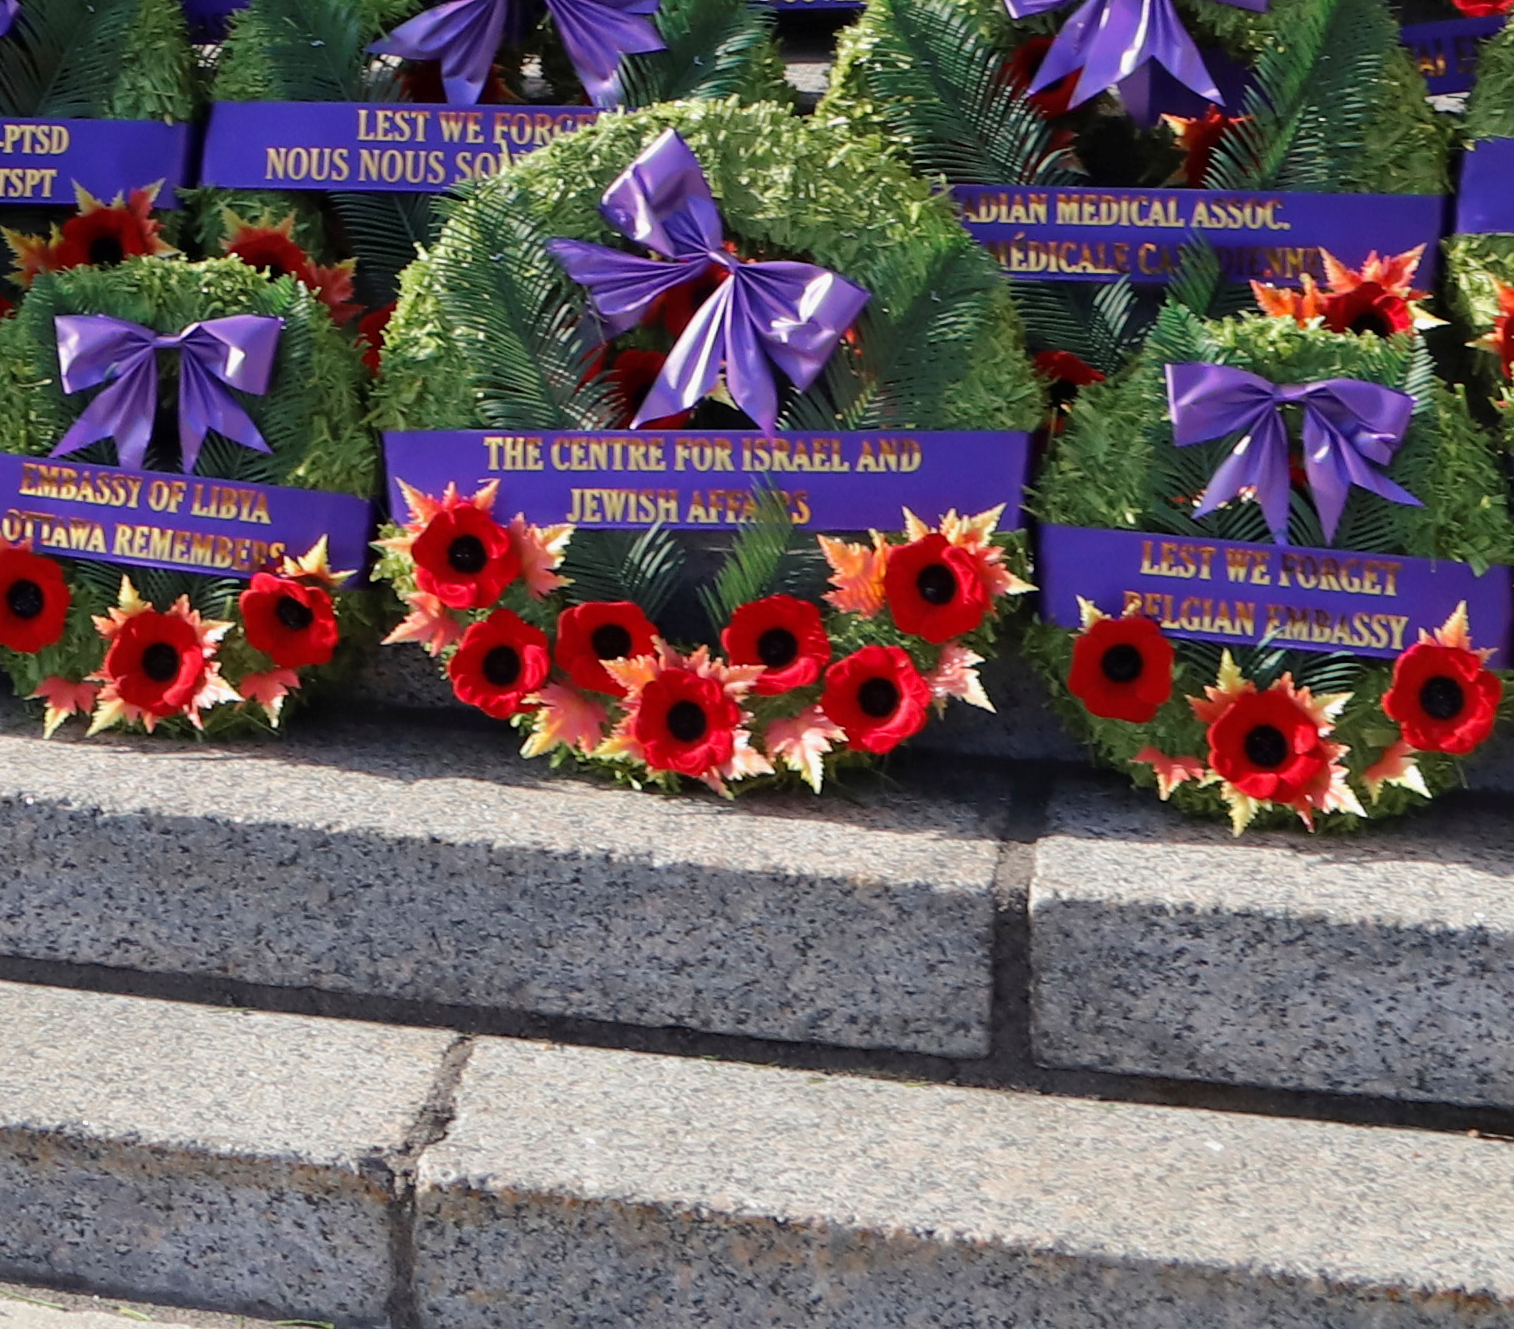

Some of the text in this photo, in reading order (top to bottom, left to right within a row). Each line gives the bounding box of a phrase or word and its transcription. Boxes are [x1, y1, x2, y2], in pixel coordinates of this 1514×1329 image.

[357, 108, 431, 142] LEST
[439, 110, 485, 144] WE
[265, 147, 350, 182] NOUS
[358, 149, 446, 185] NOUS
[1057, 193, 1186, 228] MEDICAL
[1191, 197, 1292, 231] ASSOC.
[483, 436, 922, 473] THE CENTRE FOR ISRAEL AND
[19, 463, 272, 525] EMBASSY OF LIBYA
[566, 488, 680, 524] JEWISH
[1, 508, 107, 554] OTTAWA
[1140, 541, 1403, 597] LEST WE FORGET
[1264, 603, 1410, 651] EMBASSY
